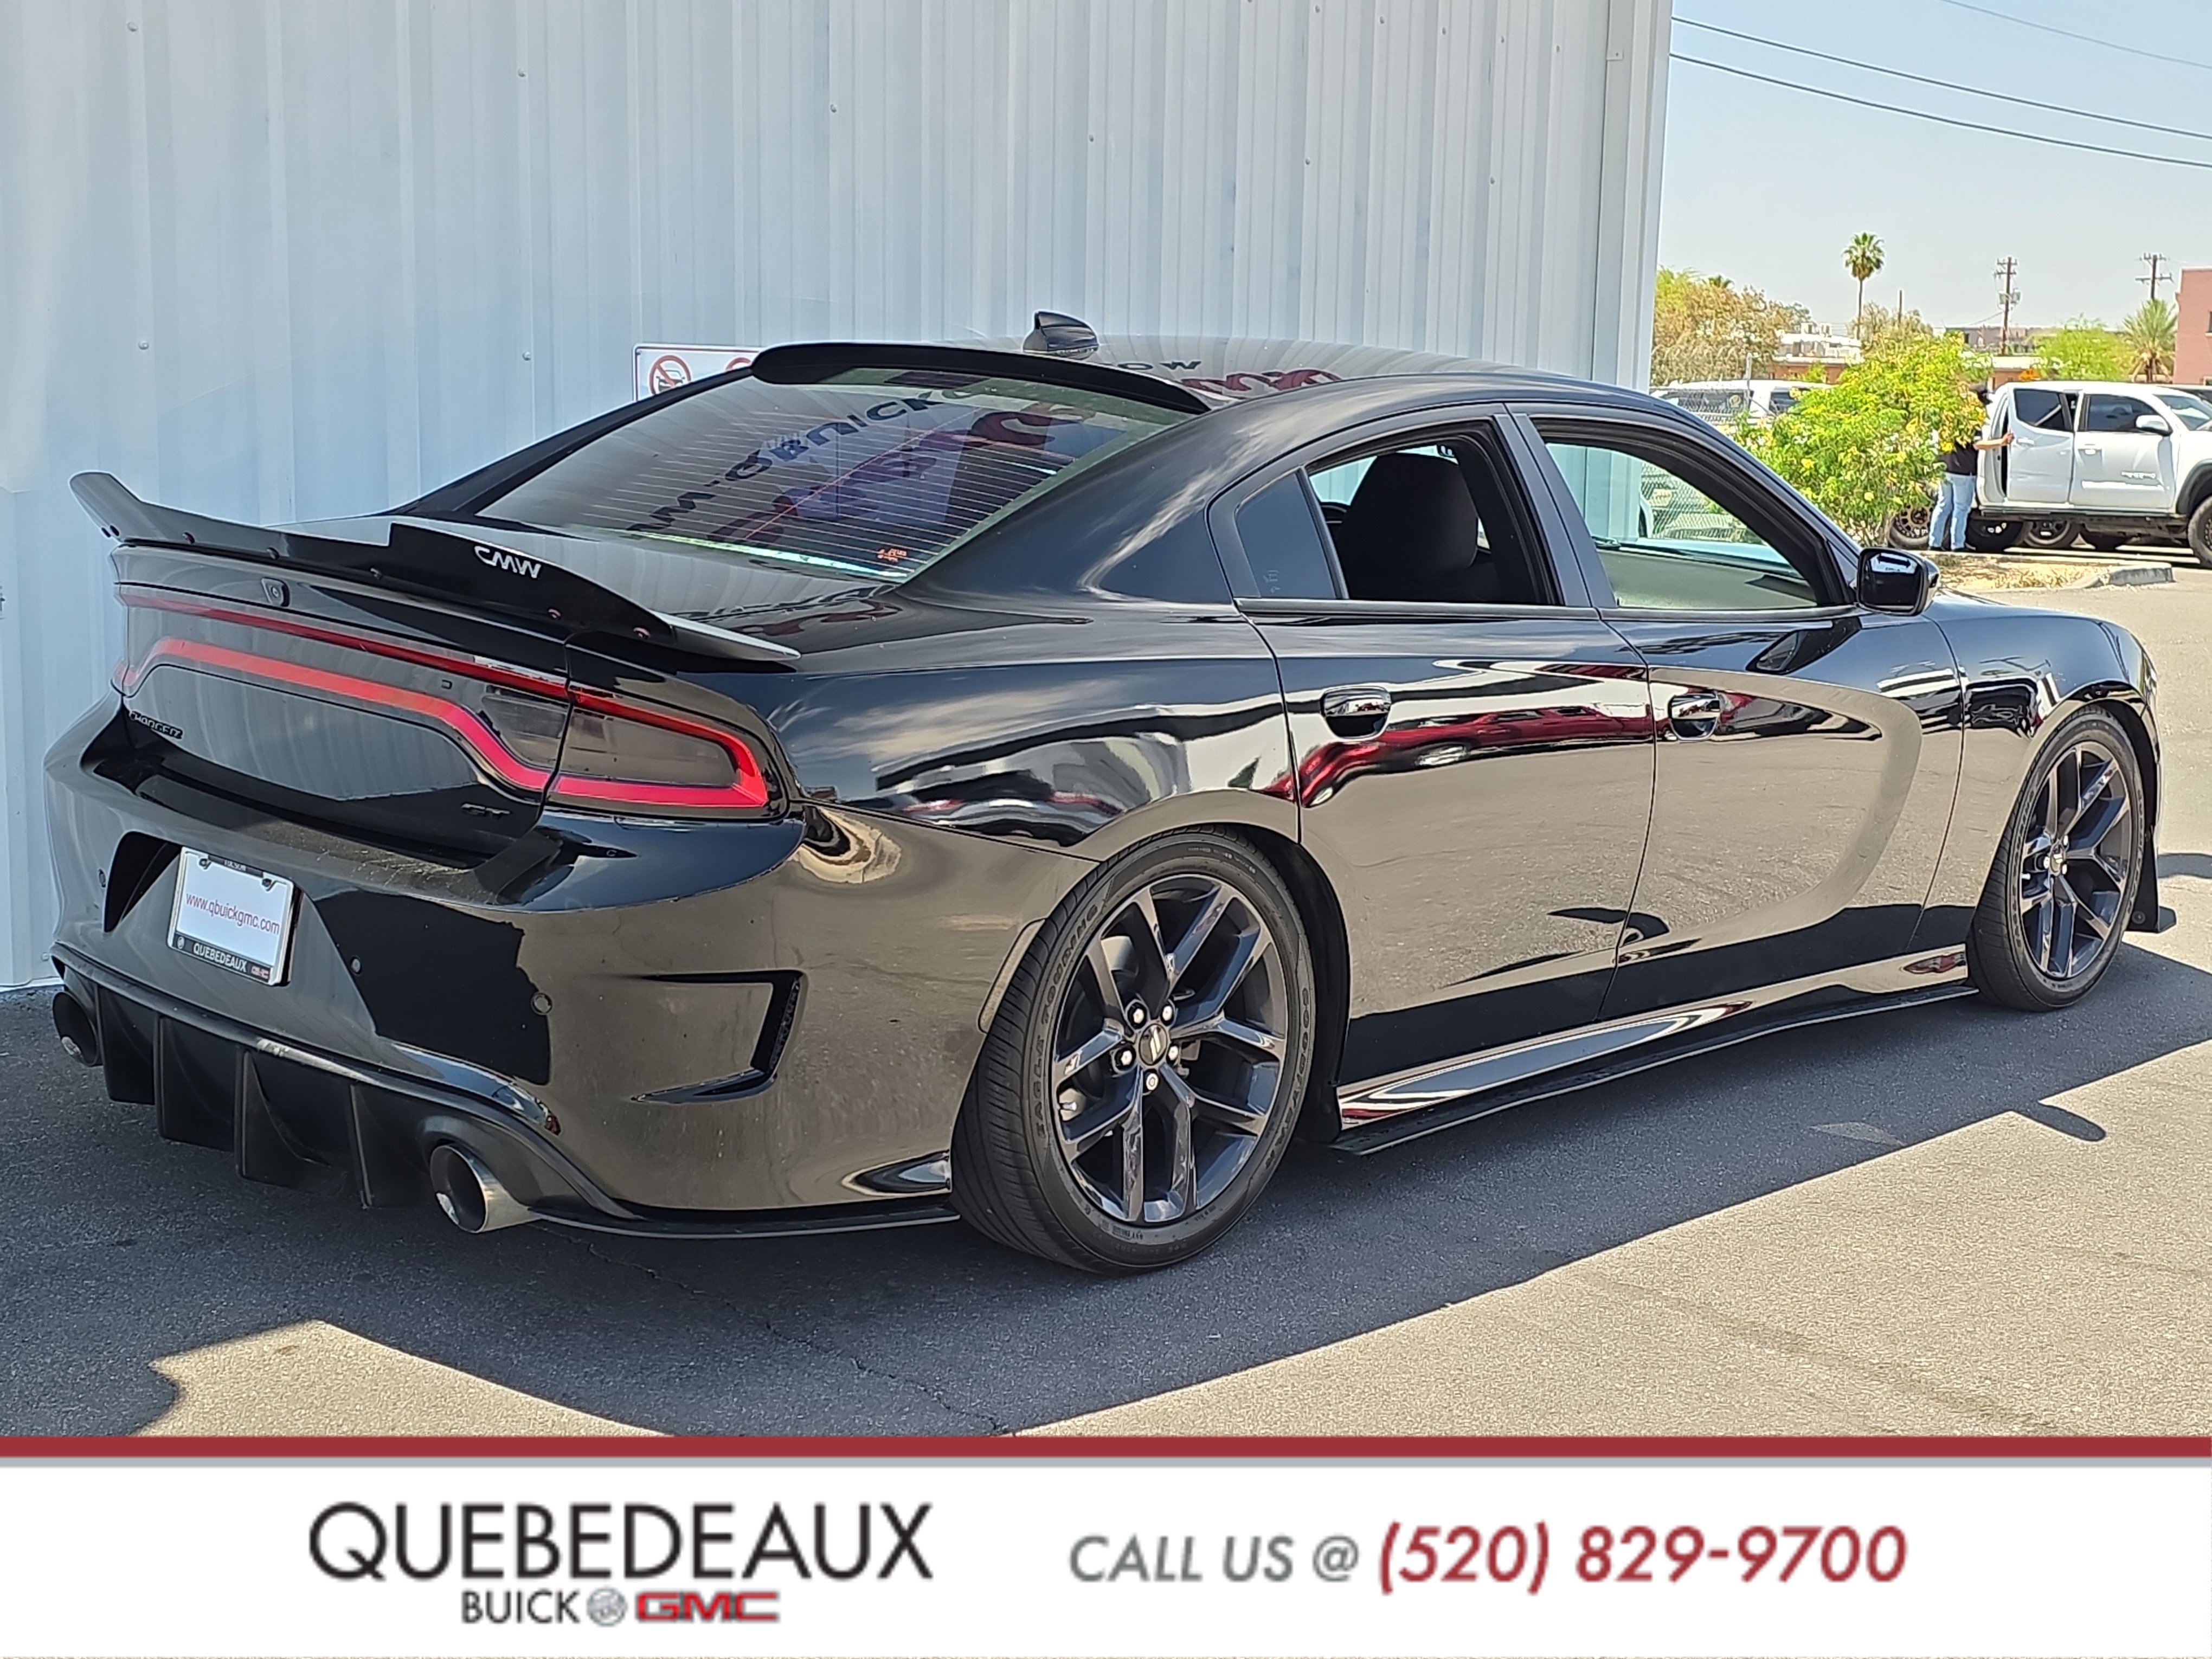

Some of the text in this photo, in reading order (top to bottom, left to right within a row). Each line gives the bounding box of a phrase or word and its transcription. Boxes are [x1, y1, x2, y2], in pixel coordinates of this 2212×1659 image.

[474, 545, 542, 579] CMW
[185, 892, 280, 936] www.qbuickgmc.com
[193, 943, 248, 973] QUEBEDEAUX
[1033, 904, 1098, 1137] EAGLE TOURING
[1265, 988, 1310, 1168] GOODYEAR
